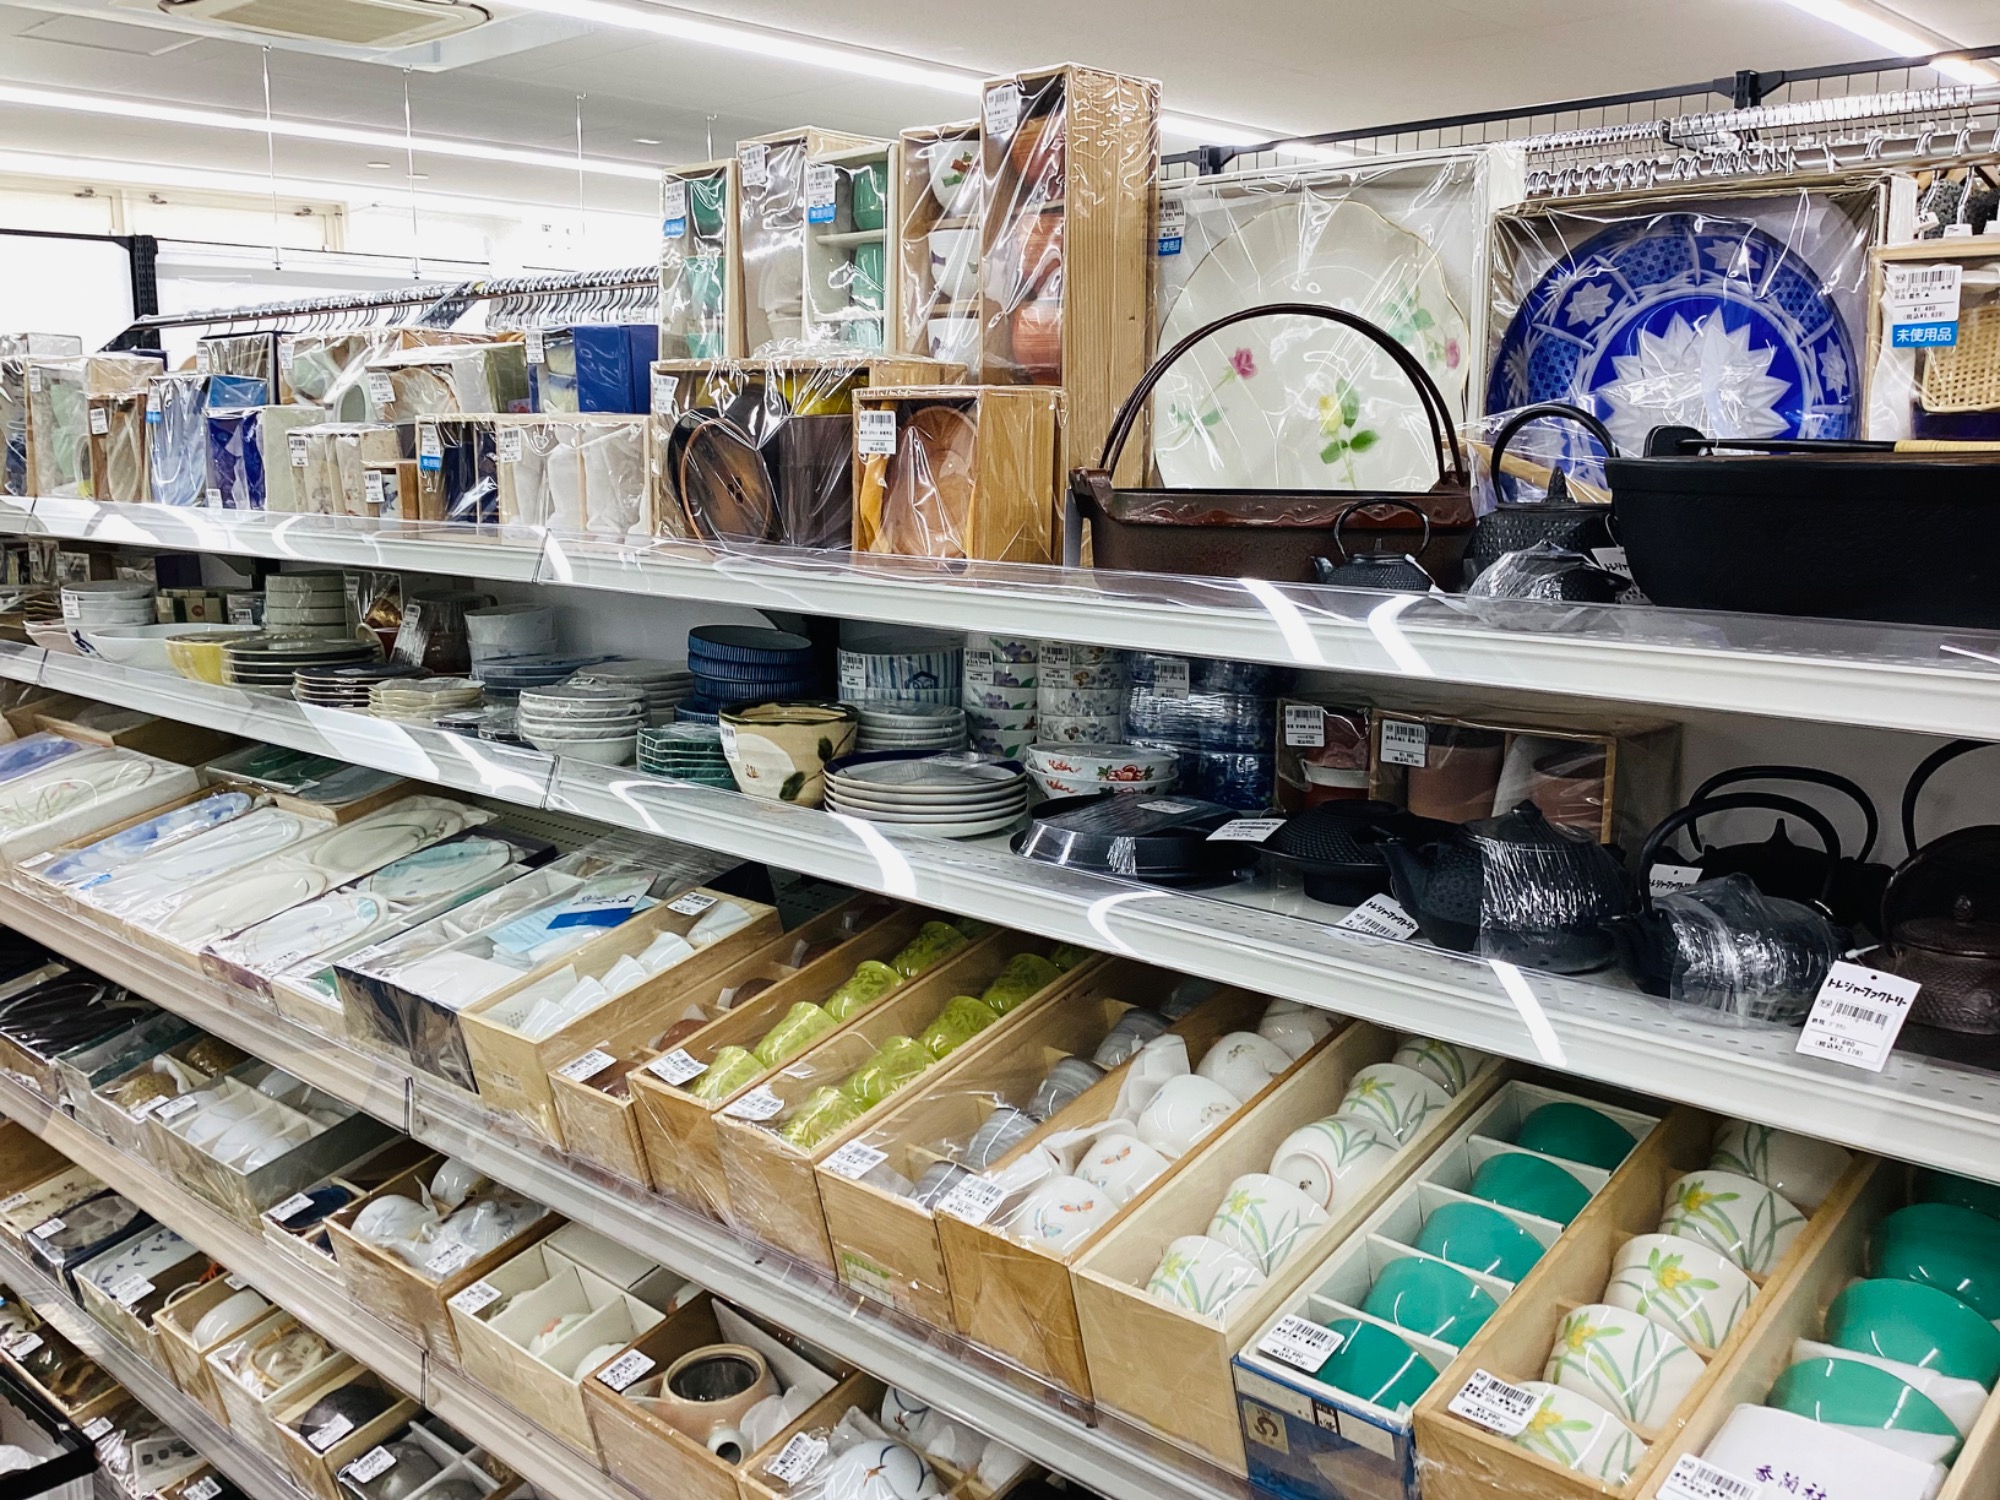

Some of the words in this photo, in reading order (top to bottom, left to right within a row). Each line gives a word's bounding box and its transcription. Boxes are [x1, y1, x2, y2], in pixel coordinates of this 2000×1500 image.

[1896, 326, 1953, 343] 未使用品
[1827, 978, 1908, 1007] トレジャーファクトリー
